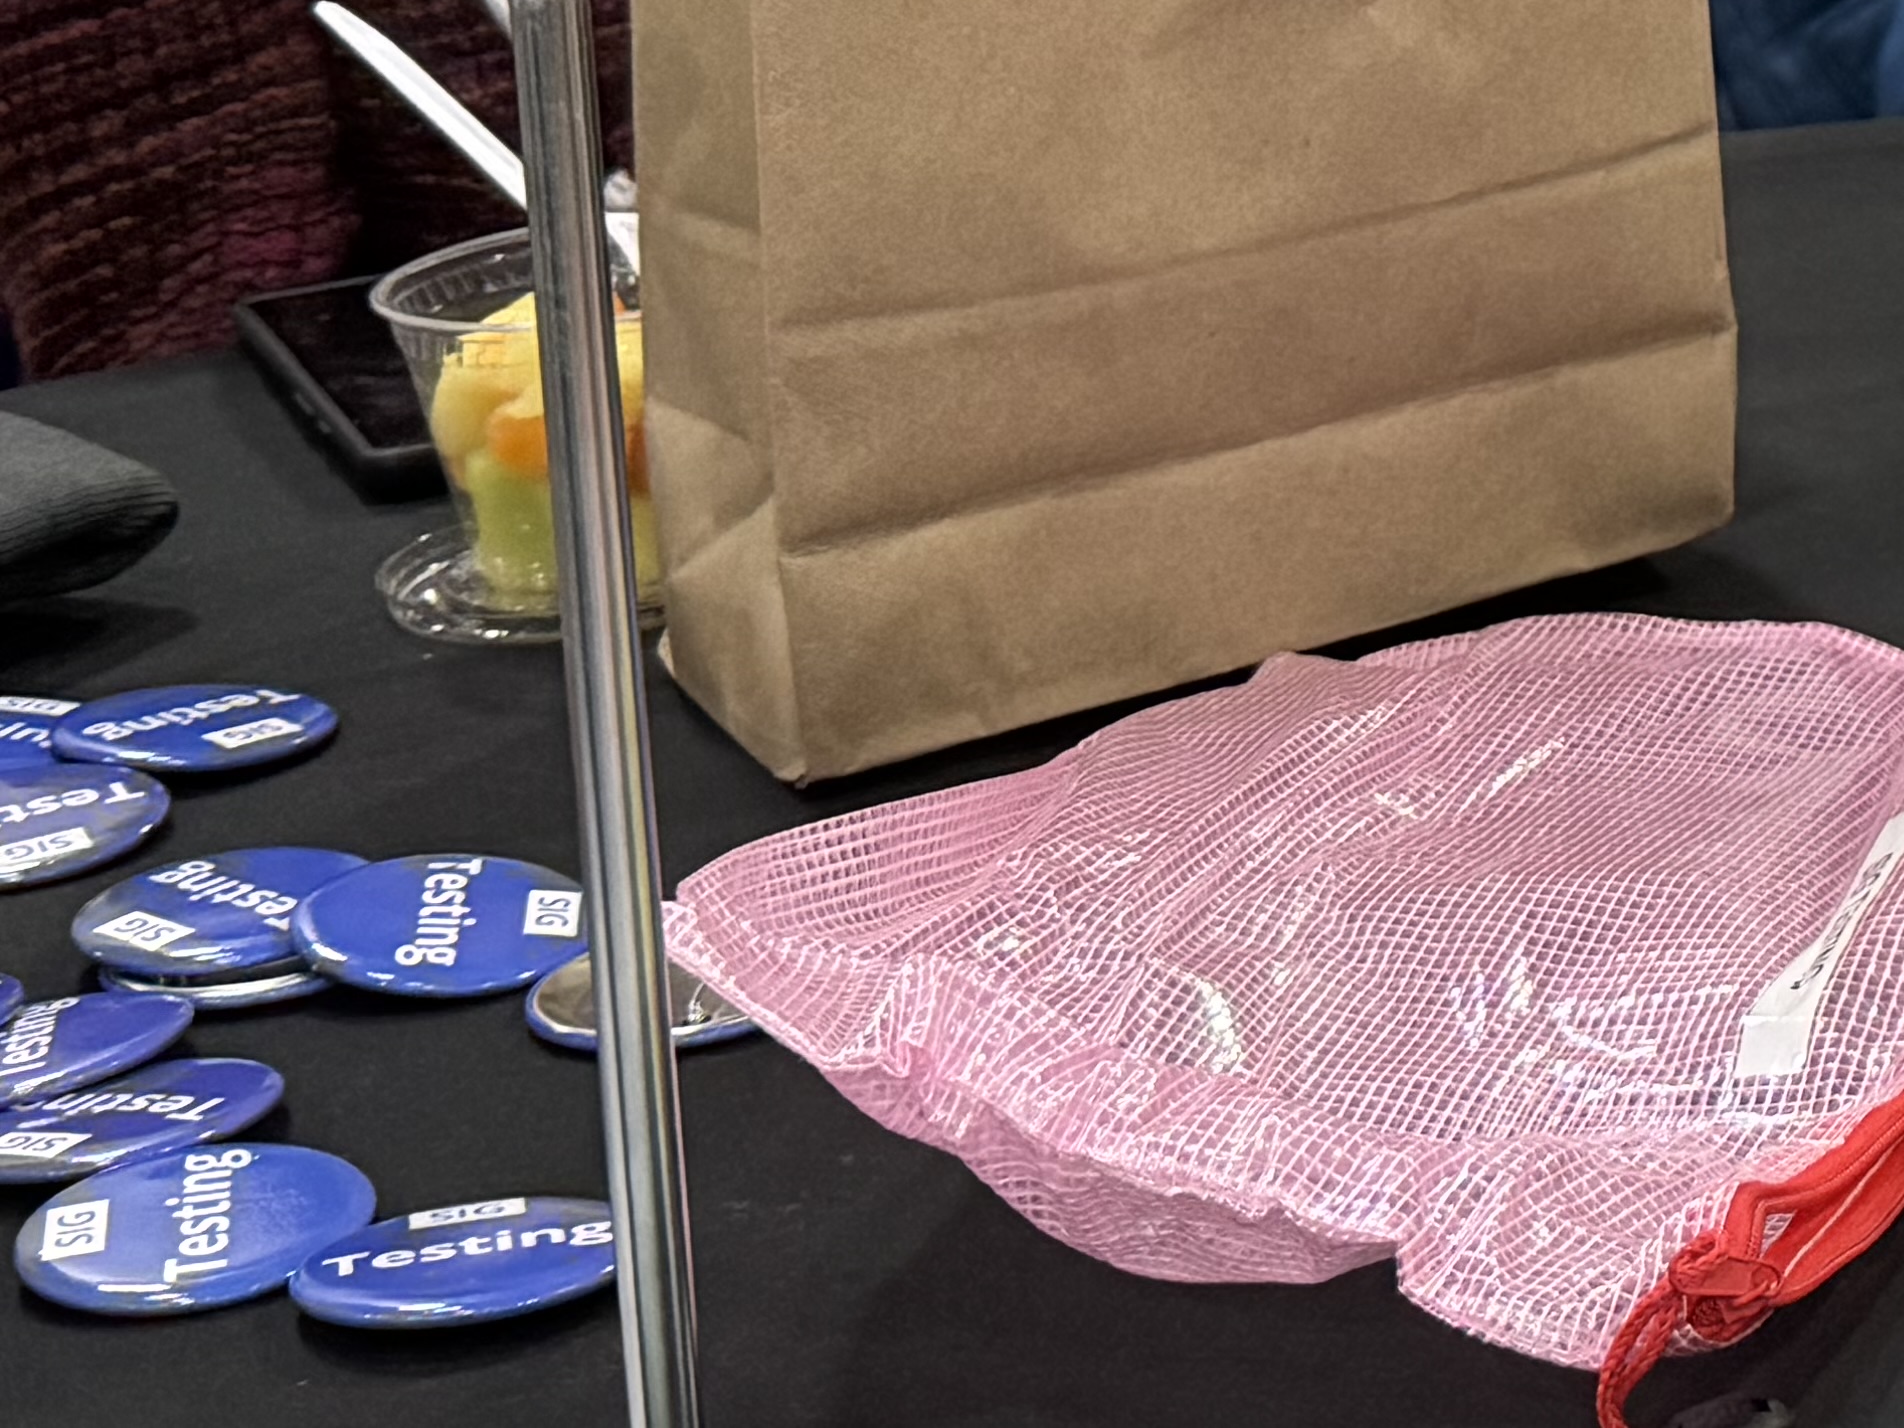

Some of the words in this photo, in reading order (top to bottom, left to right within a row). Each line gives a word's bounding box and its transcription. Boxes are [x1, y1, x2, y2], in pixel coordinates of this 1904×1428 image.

[81, 689, 303, 741] Testing
[5, 834, 75, 861] SIG
[114, 916, 177, 943] SIG
[395, 857, 485, 967] Testing
[534, 894, 573, 930] SIG
[54, 1210, 95, 1248] SIG
[164, 1149, 253, 1283] Testing
[431, 1202, 512, 1224] SIG
[322, 1220, 614, 1277] Testing
